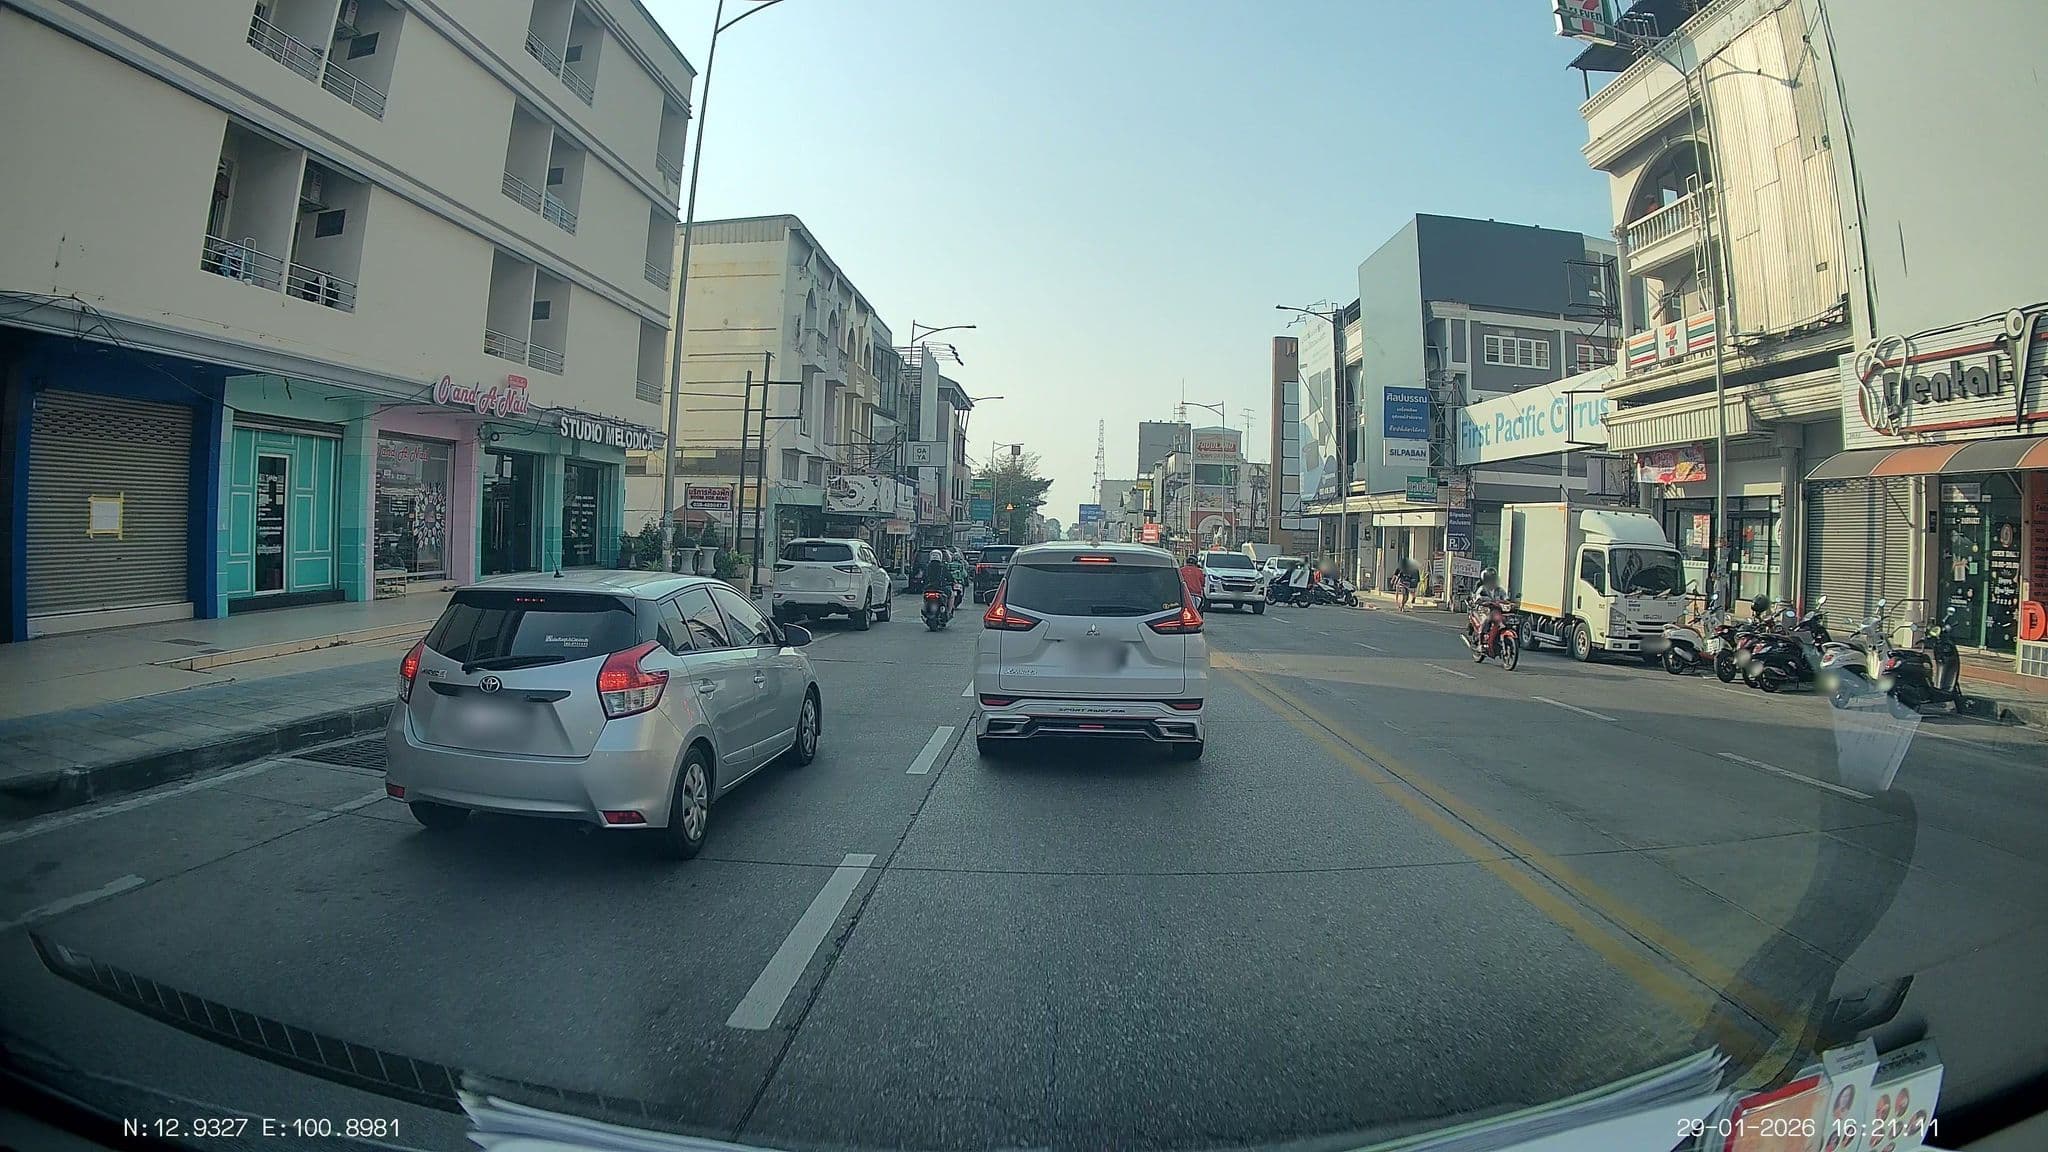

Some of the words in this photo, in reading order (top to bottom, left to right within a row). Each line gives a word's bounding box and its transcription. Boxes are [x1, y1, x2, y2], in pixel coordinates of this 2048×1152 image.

[1883, 354, 2000, 409] Dental
[496, 388, 530, 418] Nail
[560, 416, 603, 443] STUDIO
[605, 426, 654, 451] MELODICA
[1462, 420, 1490, 450] First
[1495, 404, 1545, 444] Pacific
[1550, 397, 1609, 434] Cirrus
[1389, 447, 1426, 458] SILPABAN
